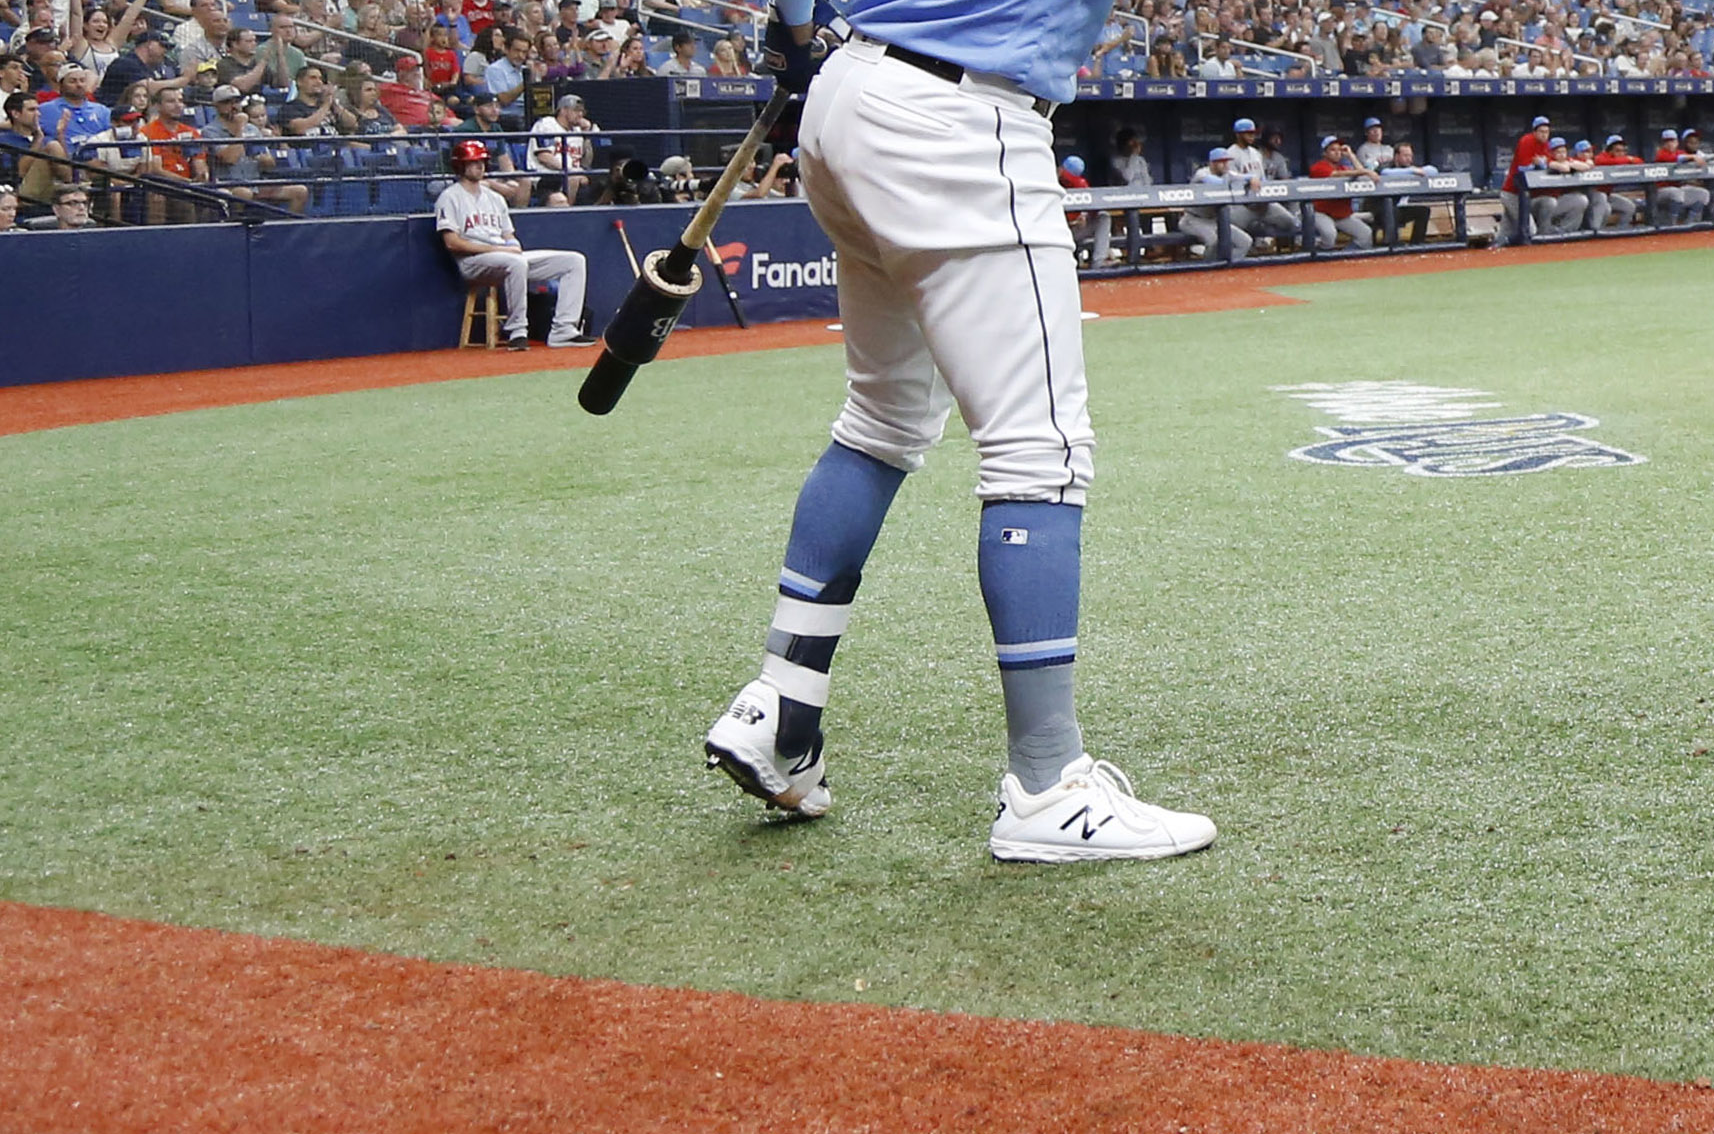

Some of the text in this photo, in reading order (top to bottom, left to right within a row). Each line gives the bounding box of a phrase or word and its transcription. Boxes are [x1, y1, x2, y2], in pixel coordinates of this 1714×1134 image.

[1428, 177, 1458, 189] NOCO
[1065, 192, 1093, 205] OCO
[1158, 189, 1195, 202] NOCO
[464, 213, 504, 232] ANGEL
[752, 251, 838, 290] Fanati
